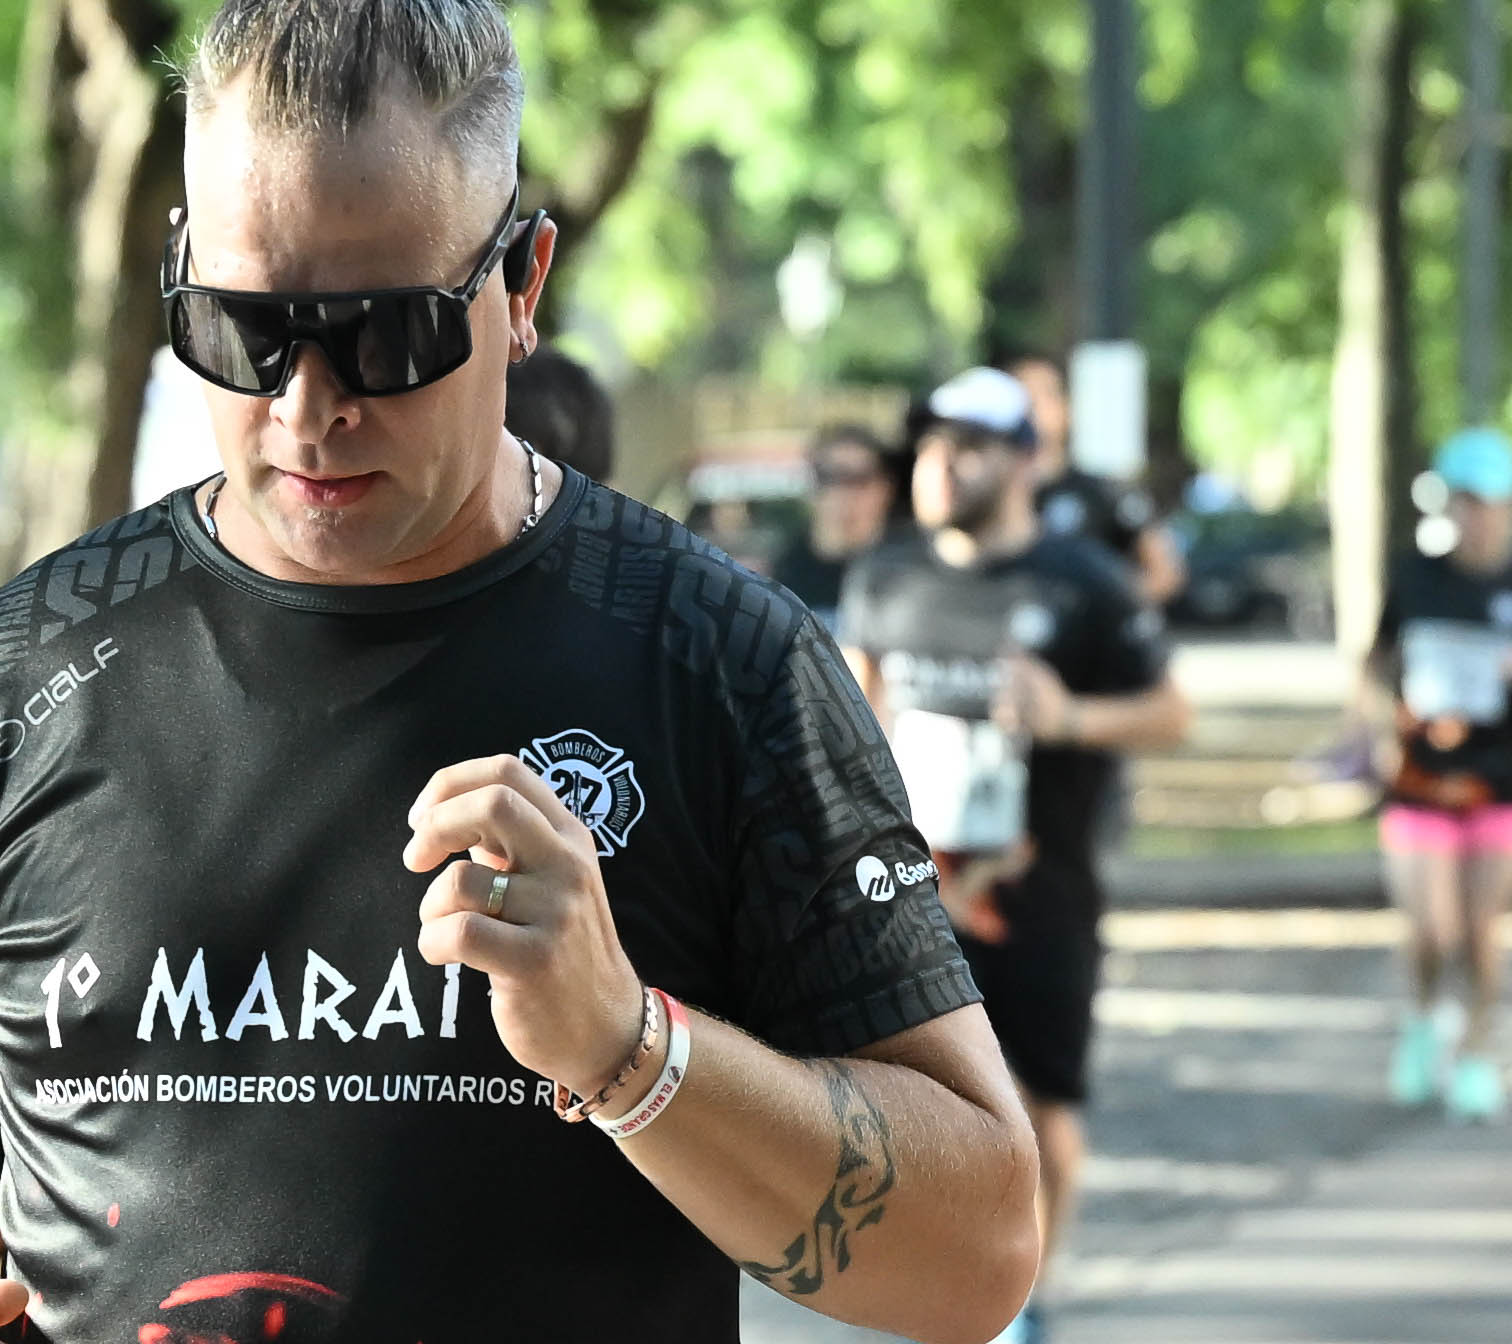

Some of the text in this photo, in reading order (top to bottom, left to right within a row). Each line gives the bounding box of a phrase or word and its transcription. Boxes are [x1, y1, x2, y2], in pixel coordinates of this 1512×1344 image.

[550, 741, 606, 763] BOMBEROS
[156, 1073, 316, 1104] BOMBEROS
[324, 1074, 526, 1105] VOLUNTARIOS
